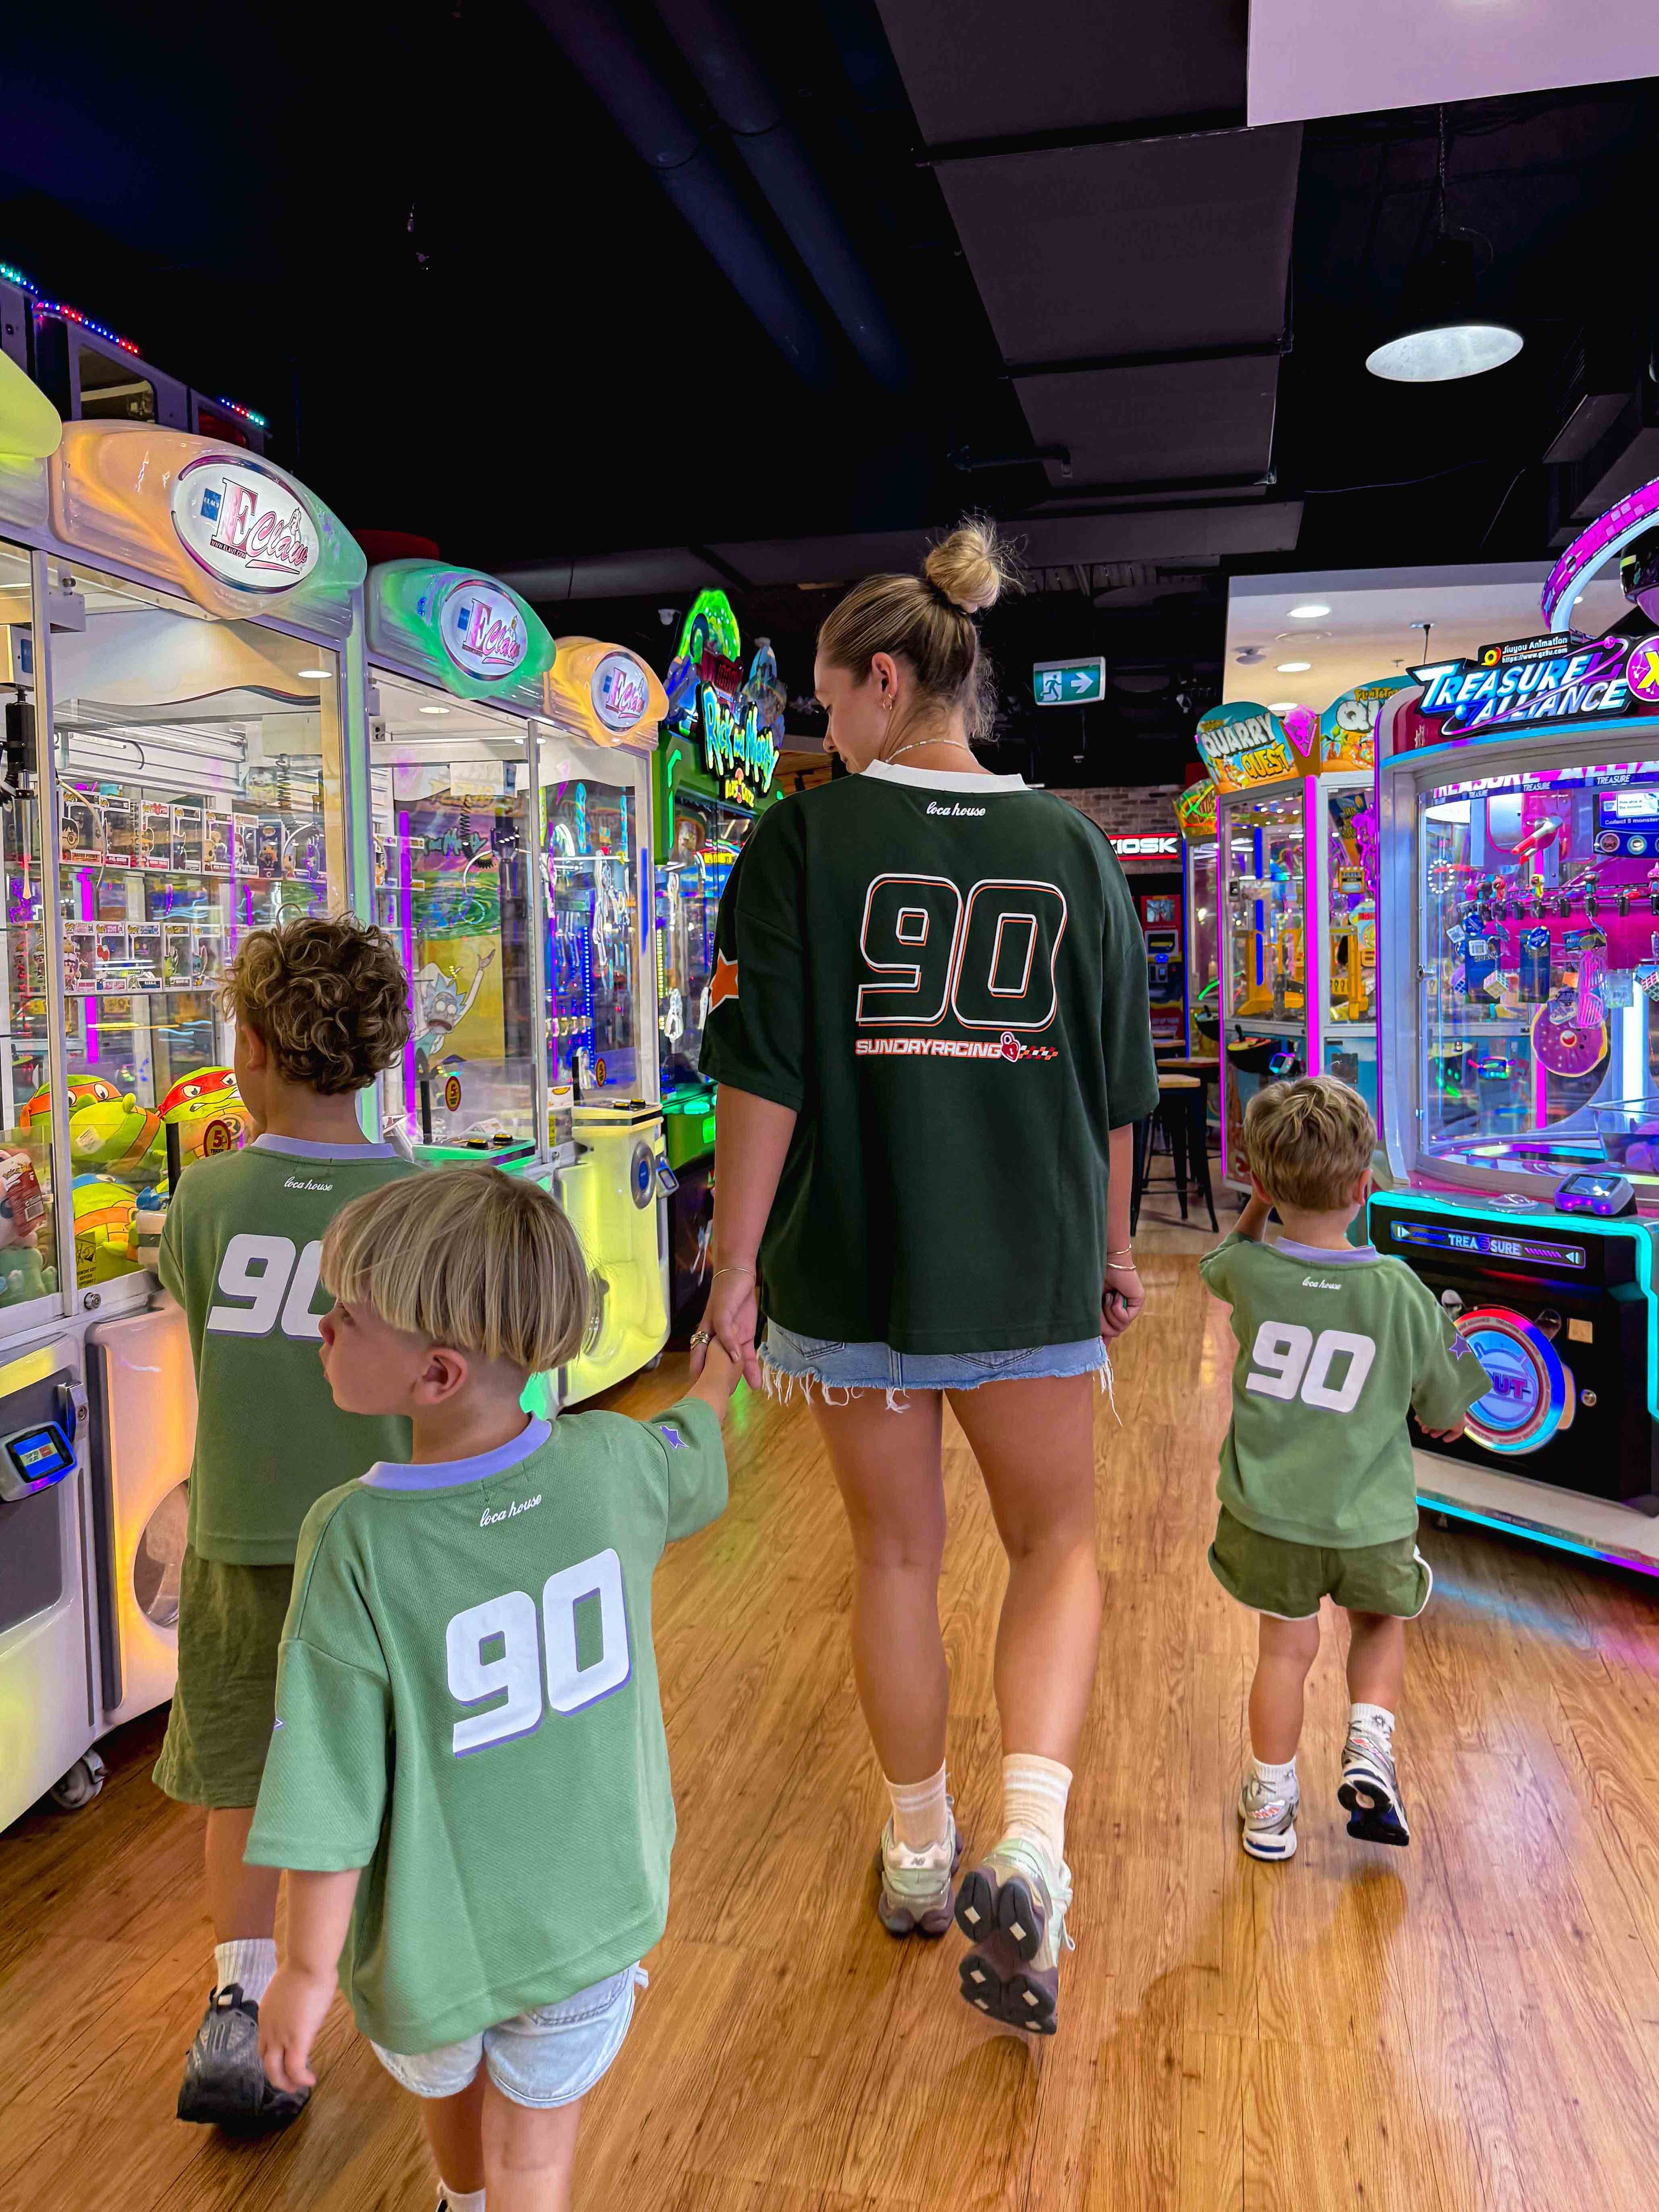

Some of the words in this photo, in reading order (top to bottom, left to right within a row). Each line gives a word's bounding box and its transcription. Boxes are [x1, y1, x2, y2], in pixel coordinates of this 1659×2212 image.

[1502, 644, 1527, 654] Jiuyou
[1529, 636, 1568, 649] Animation
[1414, 654, 1592, 710] TREASURE
[1471, 678, 1629, 727] ALLIANCE
[1201, 712, 1275, 759] QUARRY
[1241, 743, 1290, 779] QUEST
[1523, 782, 1551, 791] TREASURE
[1597, 774, 1630, 785] TREASURE
[927, 801, 951, 816] loca
[952, 803, 986, 816] house
[856, 873, 1068, 1032] 90
[284, 1176, 304, 1190] loca
[304, 1179, 333, 1192] house
[1448, 1233, 1478, 1250] TREA
[1490, 1242, 1522, 1256] SURE
[1302, 1276, 1319, 1288] loca
[1319, 1277, 1342, 1290] house
[1246, 1321, 1376, 1413] 90
[480, 1508, 507, 1528] loca
[508, 1494, 542, 1518] house
[445, 1548, 631, 1758] 90
